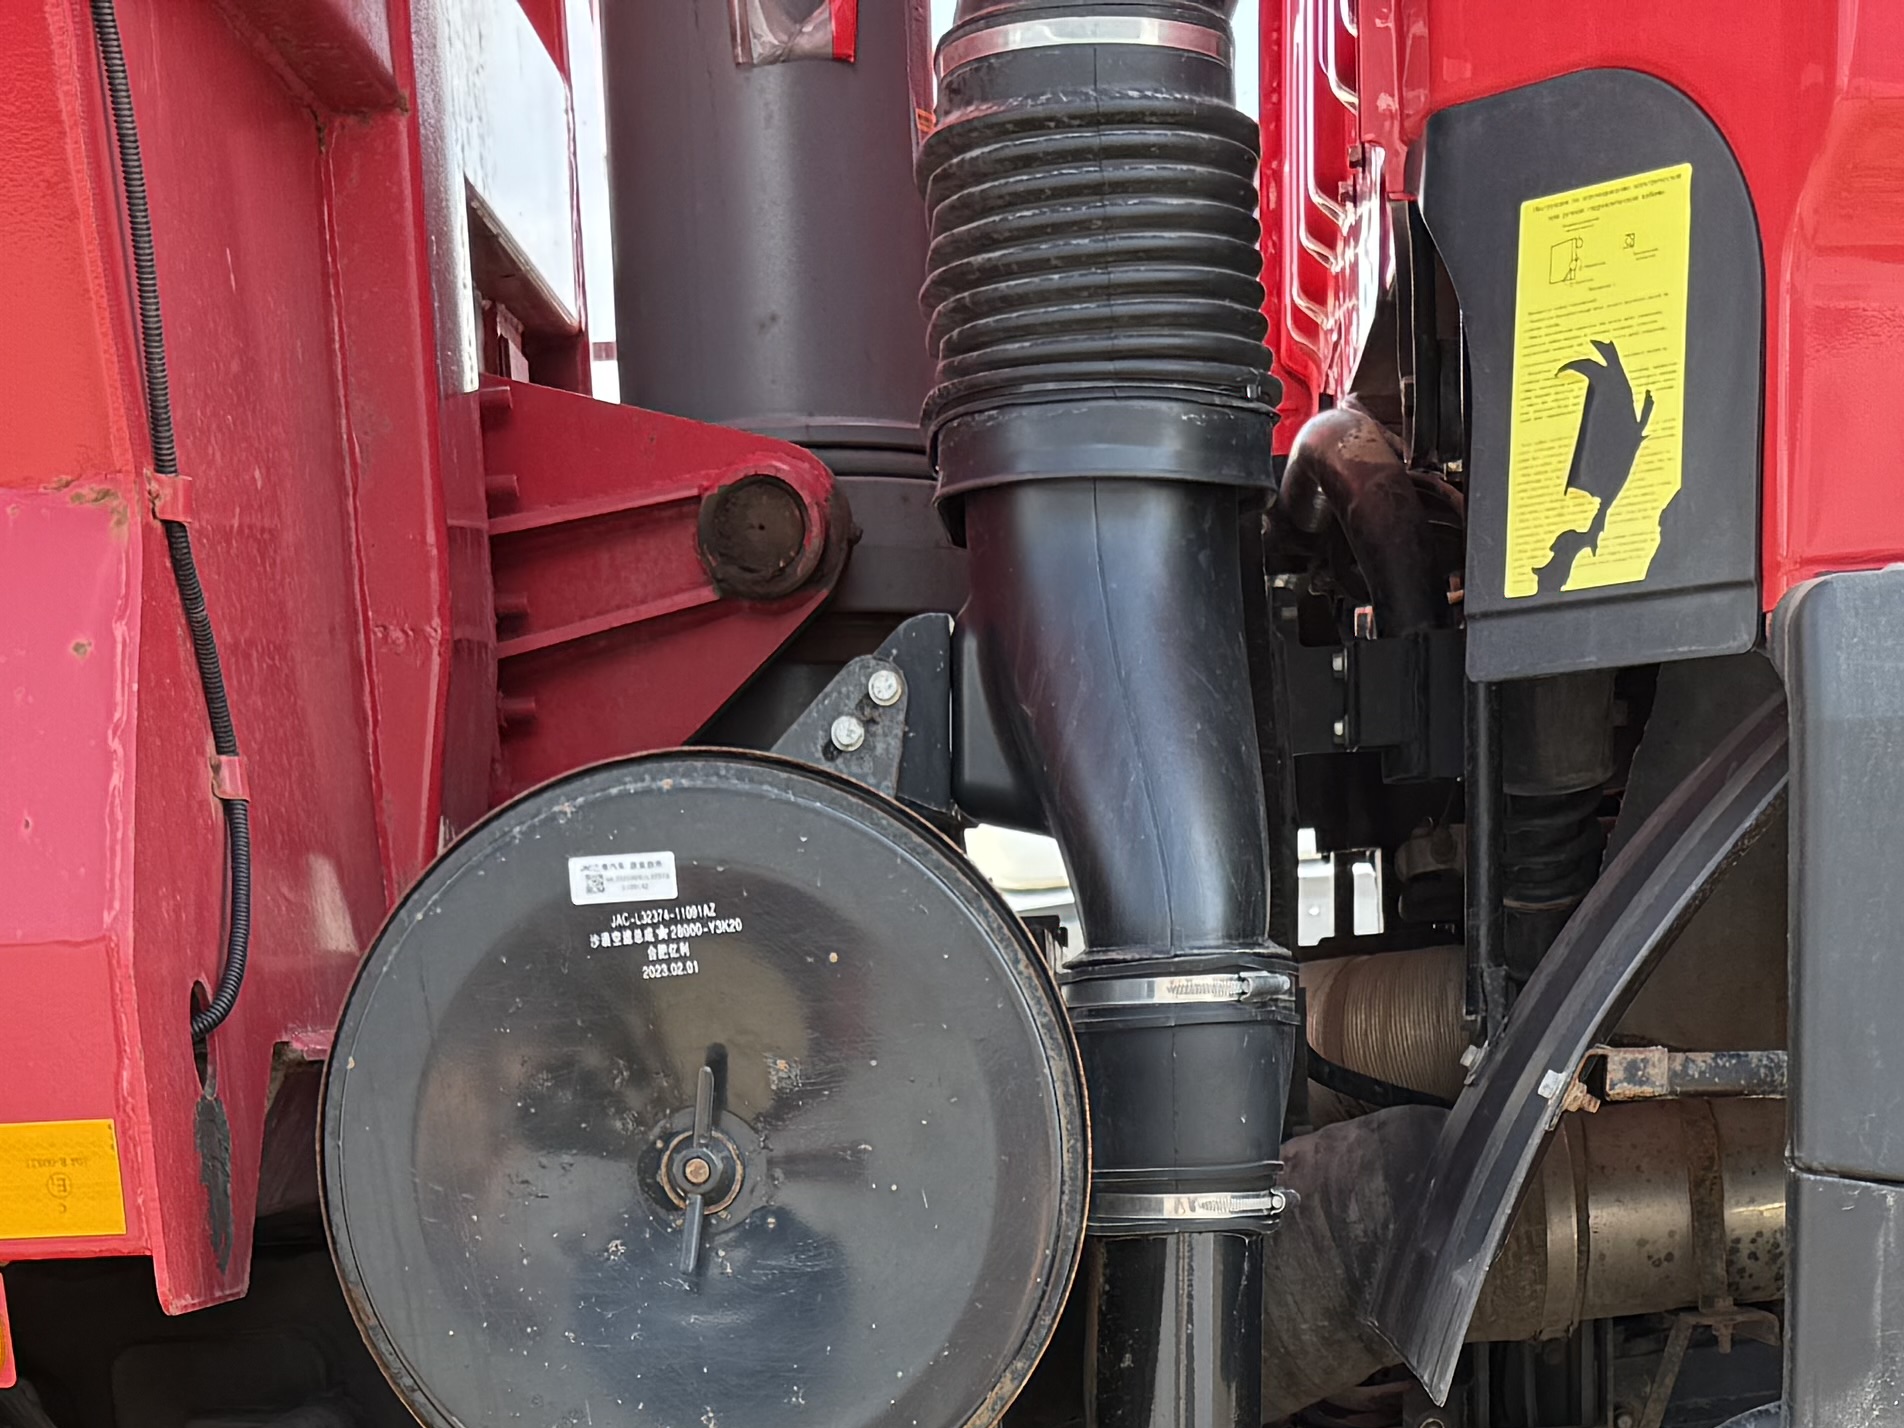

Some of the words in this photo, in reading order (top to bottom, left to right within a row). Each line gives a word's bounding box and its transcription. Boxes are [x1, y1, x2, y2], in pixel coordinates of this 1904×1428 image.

[646, 941, 691, 962] 合肥亿利
[641, 960, 700, 980] 2023.02.01
